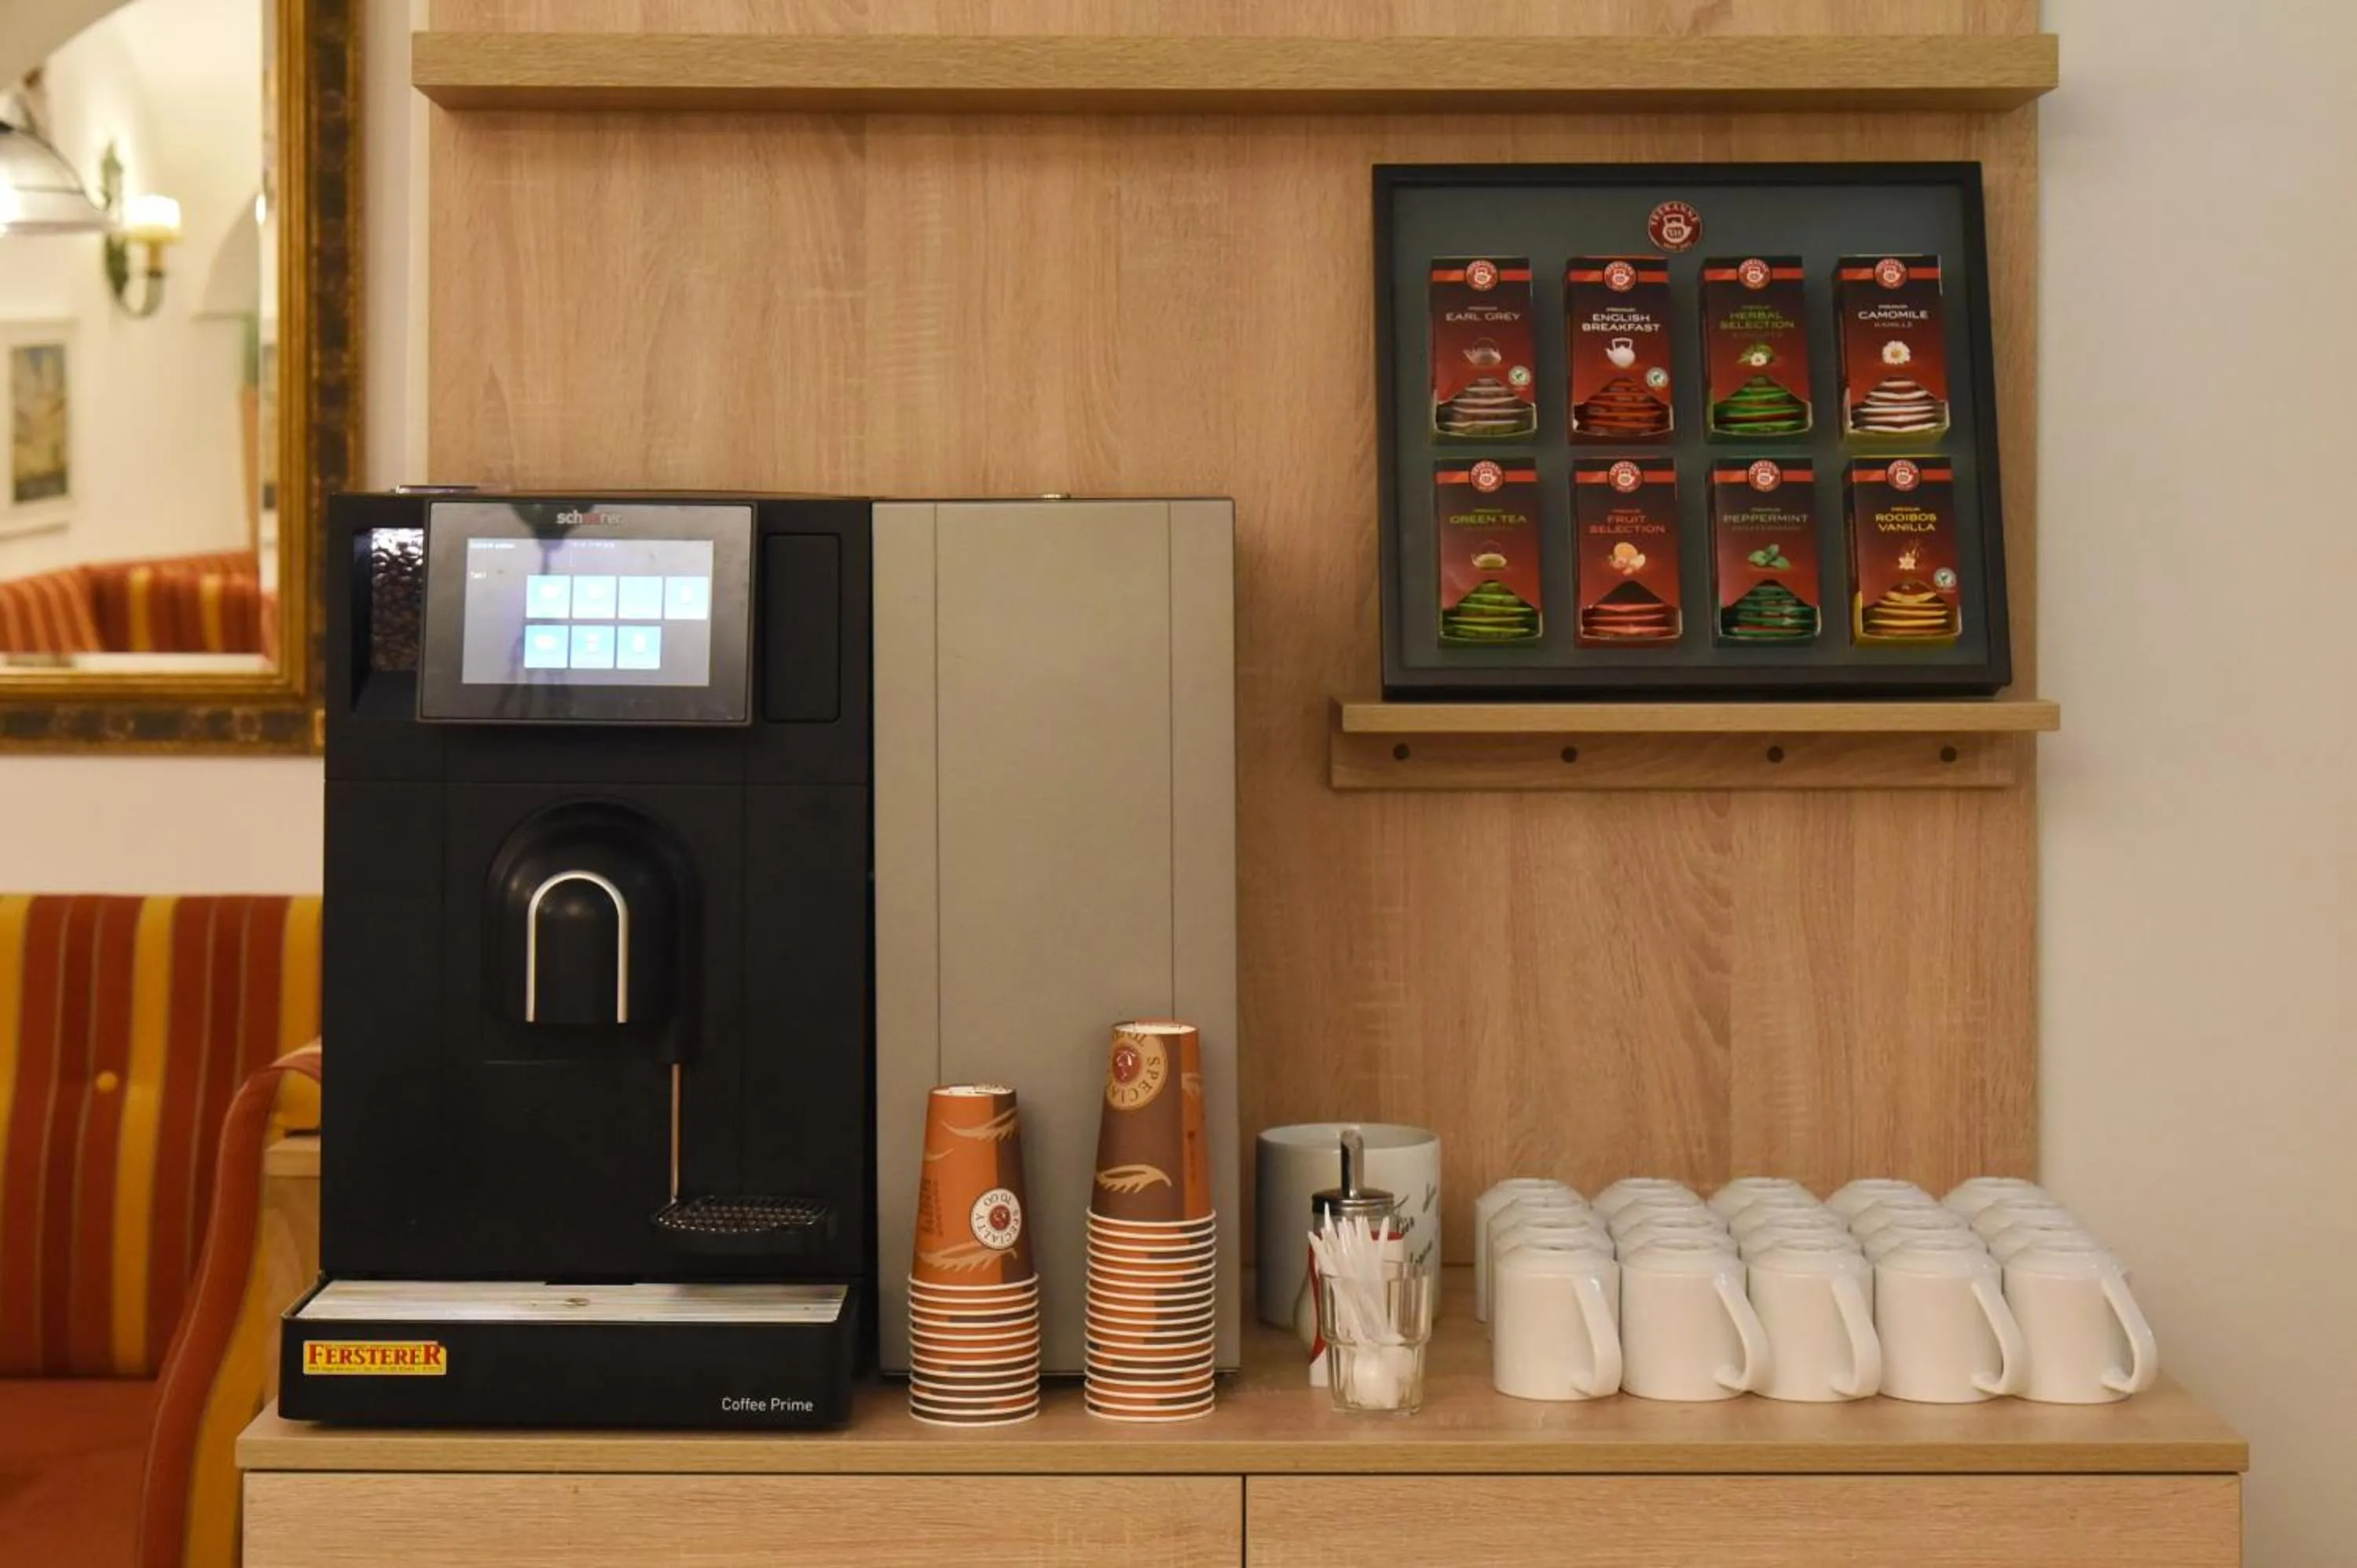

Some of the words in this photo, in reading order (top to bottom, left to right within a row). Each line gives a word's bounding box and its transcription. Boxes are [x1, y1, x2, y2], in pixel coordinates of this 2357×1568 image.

[1446, 312, 1483, 321] EARL
[1484, 312, 1520, 321] GREY
[1593, 313, 1650, 322] ENGLISH
[1857, 310, 1929, 320] CAMOMILE
[1581, 323, 1660, 332] BREAKFAST
[1450, 515, 1496, 524] GREEN
[1498, 515, 1527, 524] TEA
[1607, 515, 1646, 523] FRUIT
[1723, 514, 1809, 523] PEPPERMINT
[1875, 513, 1937, 522] ROOIBOS
[1589, 524, 1665, 533] SELECTION
[1878, 522, 1936, 532] VANILLA
[307, 1344, 441, 1365] FERSTERER
[721, 1397, 767, 1412] Coffee
[770, 1397, 814, 1412] Prime
